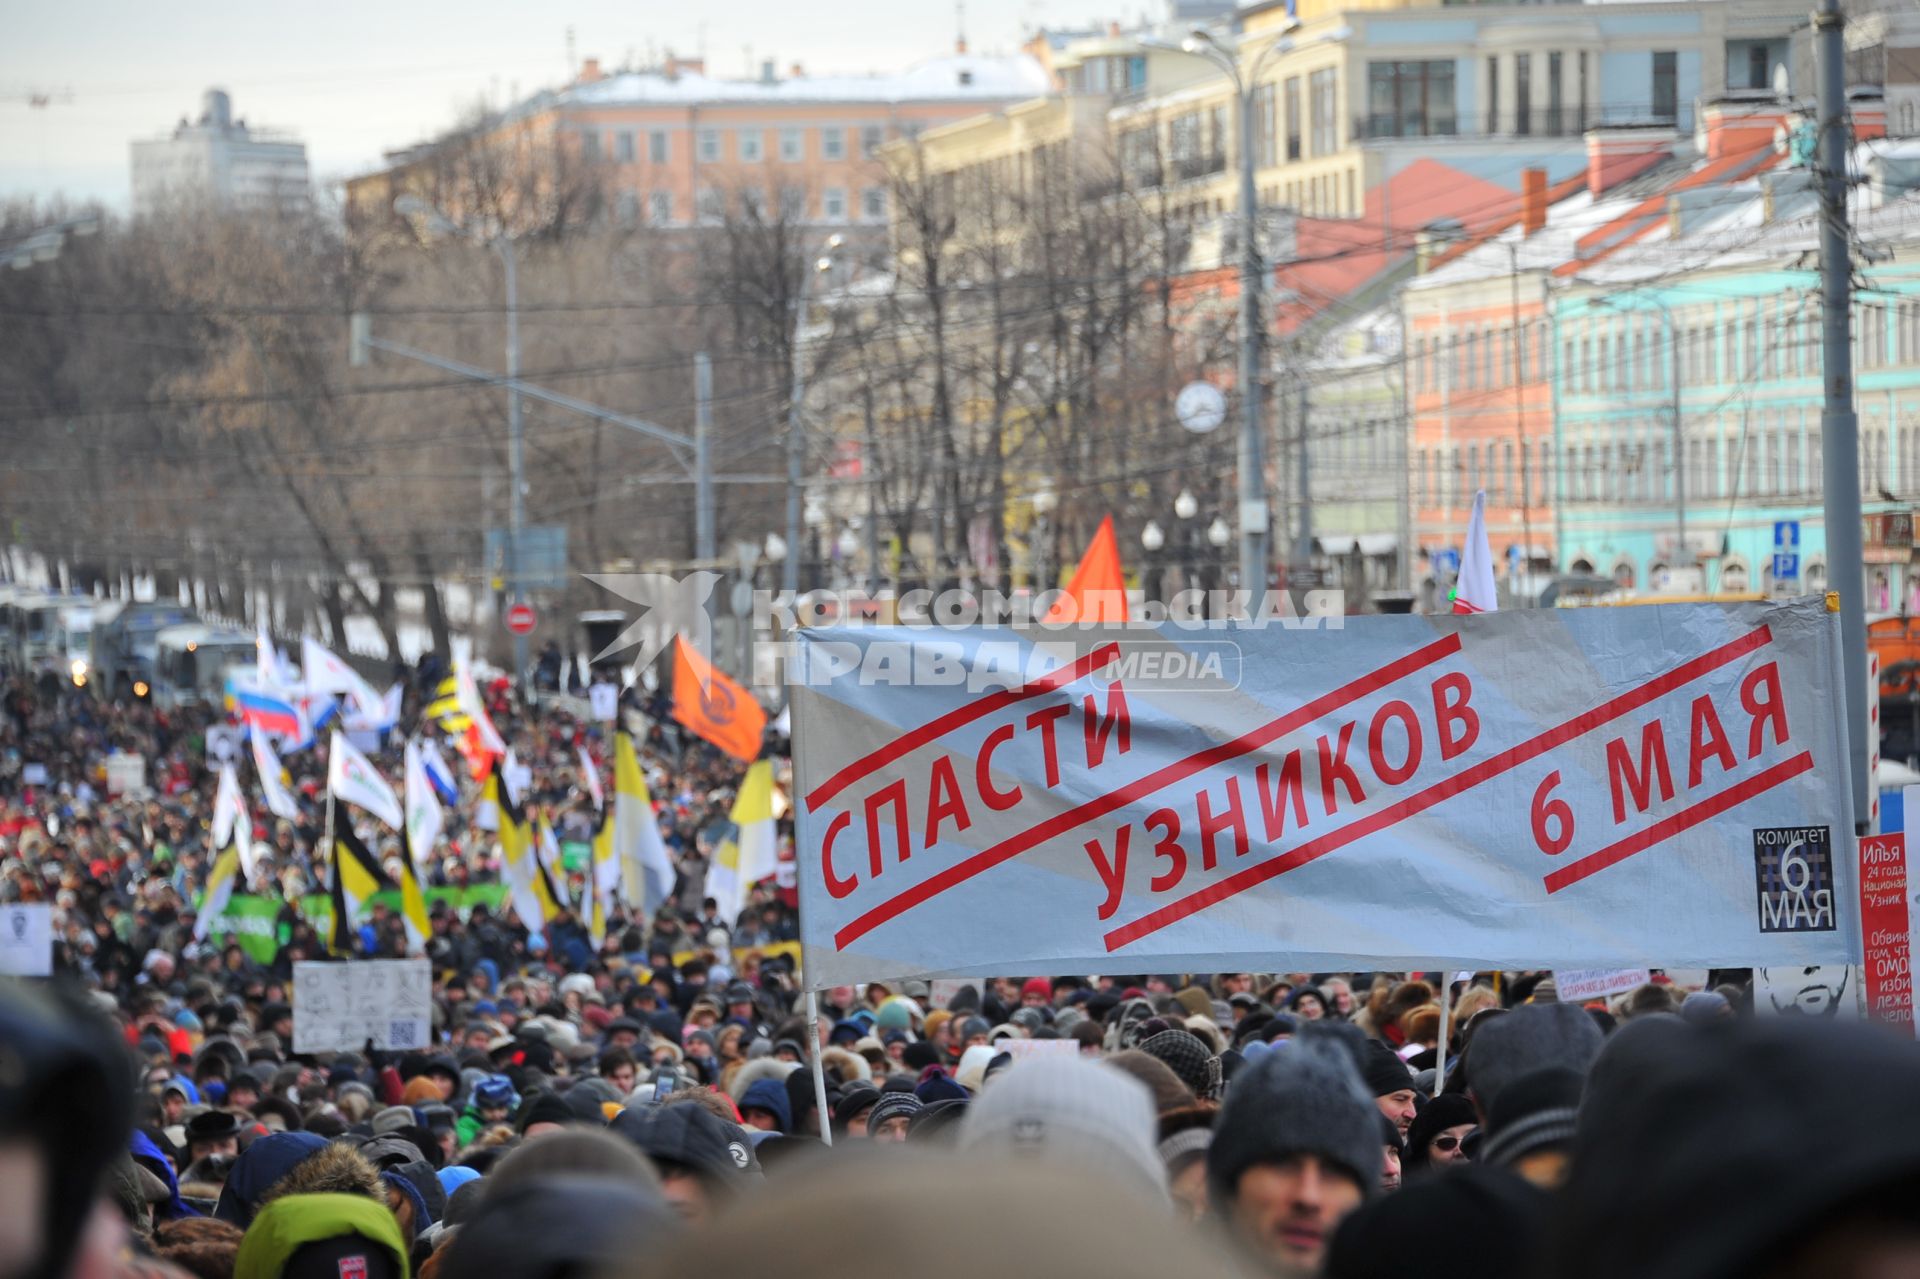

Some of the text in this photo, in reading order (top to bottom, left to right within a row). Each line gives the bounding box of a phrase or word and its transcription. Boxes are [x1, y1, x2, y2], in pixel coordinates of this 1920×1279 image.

[1530, 660, 1790, 856] 6 МАЯ
[821, 679, 1132, 900] СПАСТИ
[1083, 671, 1481, 921] УЗНИКОВ
[1781, 839, 1810, 893] 6
[1863, 845, 1900, 864] Илья
[1867, 866, 1879, 878] 24
[1761, 889, 1834, 929] МАЯ
[1876, 957, 1911, 977] ОМО
[1894, 944, 1910, 957] чт
